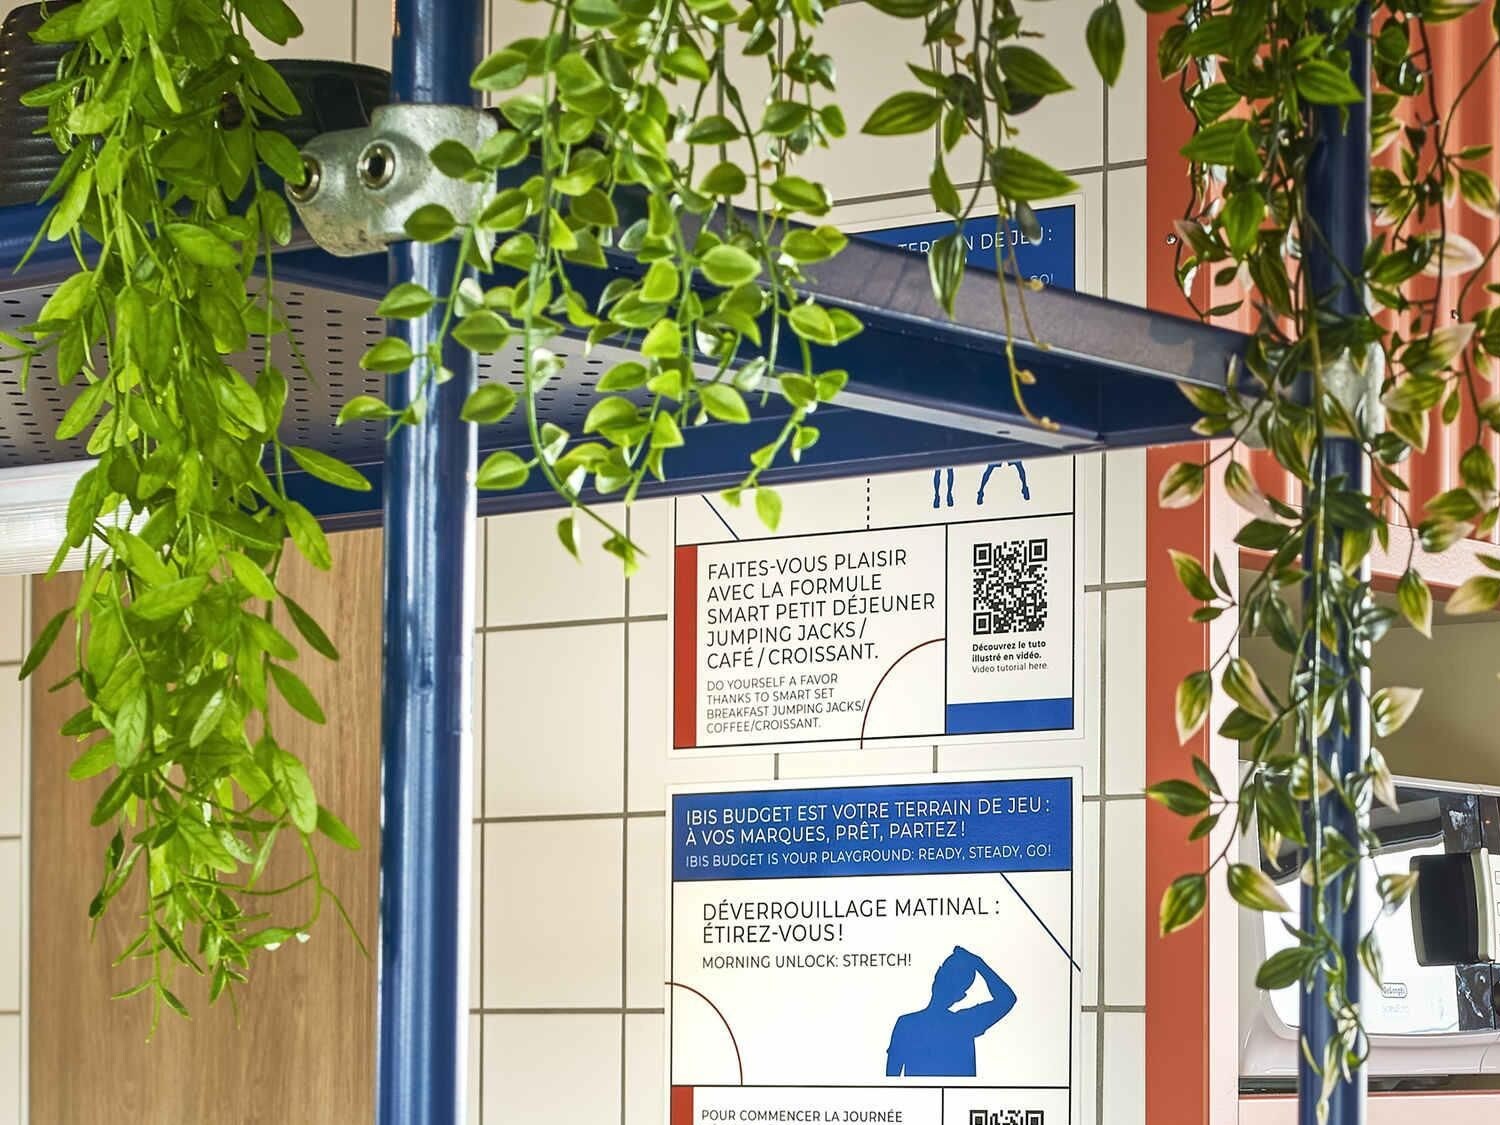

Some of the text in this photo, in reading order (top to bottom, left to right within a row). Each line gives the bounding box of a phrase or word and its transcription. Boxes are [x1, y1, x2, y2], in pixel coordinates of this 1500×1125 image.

[708, 549, 907, 580] FAITES-VOUS PLAISIR
[707, 573, 882, 602] AVEC LA FORMULE
[707, 593, 936, 624] SMART PETIT DÉJEUNER
[707, 626, 791, 647] JUMPING
[972, 643, 1016, 652] Découvrez
[972, 653, 1001, 662] illustré
[1016, 651, 1041, 660] vidéo.
[997, 663, 1026, 672] tutorial
[707, 673, 838, 692] DO YOURSELF A FAVOR
[707, 688, 834, 705] THANKS TO SMART SET
[707, 706, 769, 720] BREAKFAST
[772, 703, 823, 717] JUMPING
[686, 809, 717, 825] IBIS
[724, 806, 792, 825] BUDGET
[798, 805, 827, 821] EST
[832, 802, 888, 820] VOTRE
[895, 799, 970, 817] TERRAIN
[978, 799, 1002, 815] DE
[686, 828, 697, 846] À
[701, 829, 735, 846] VOS
[741, 826, 830, 844] MARQUES,
[836, 821, 884, 842] PRÊT,
[686, 844, 1051, 868] IBIS BUDGET IS YOUR PLAYGROUND: READY, STEADY, GO!
[703, 899, 888, 921] DÉVERROUILLAGE
[895, 897, 989, 917] MATINAL
[702, 953, 912, 969] MORNING UNLOCK: STRETCH!
[701, 1108, 903, 1123] POUR COMMENCER LA JOURNÉE
